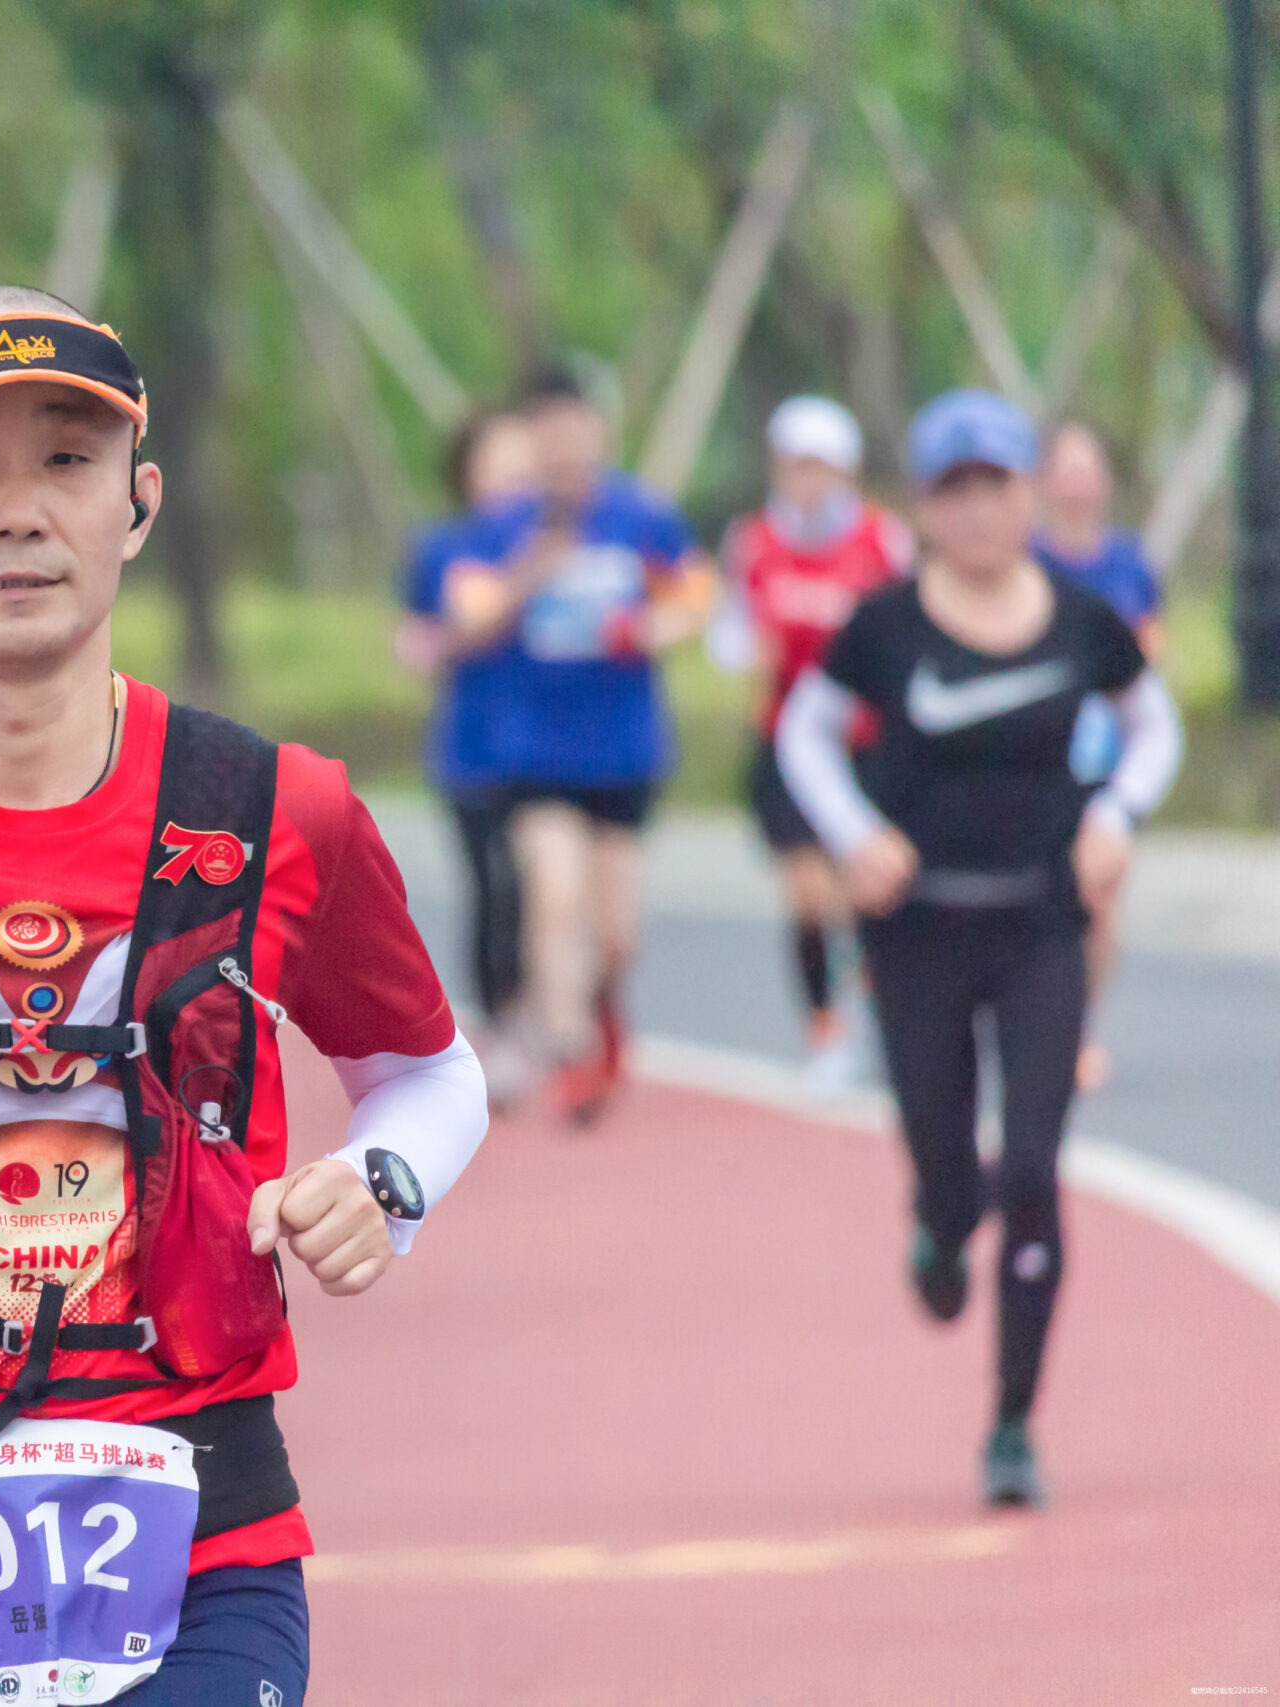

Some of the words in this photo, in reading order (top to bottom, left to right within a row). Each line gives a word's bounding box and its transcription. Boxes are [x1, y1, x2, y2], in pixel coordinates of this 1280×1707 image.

[153, 821, 245, 887] 70
[54, 1160, 90, 1198] 19
[10, 1603, 49, 1634] 岳强
